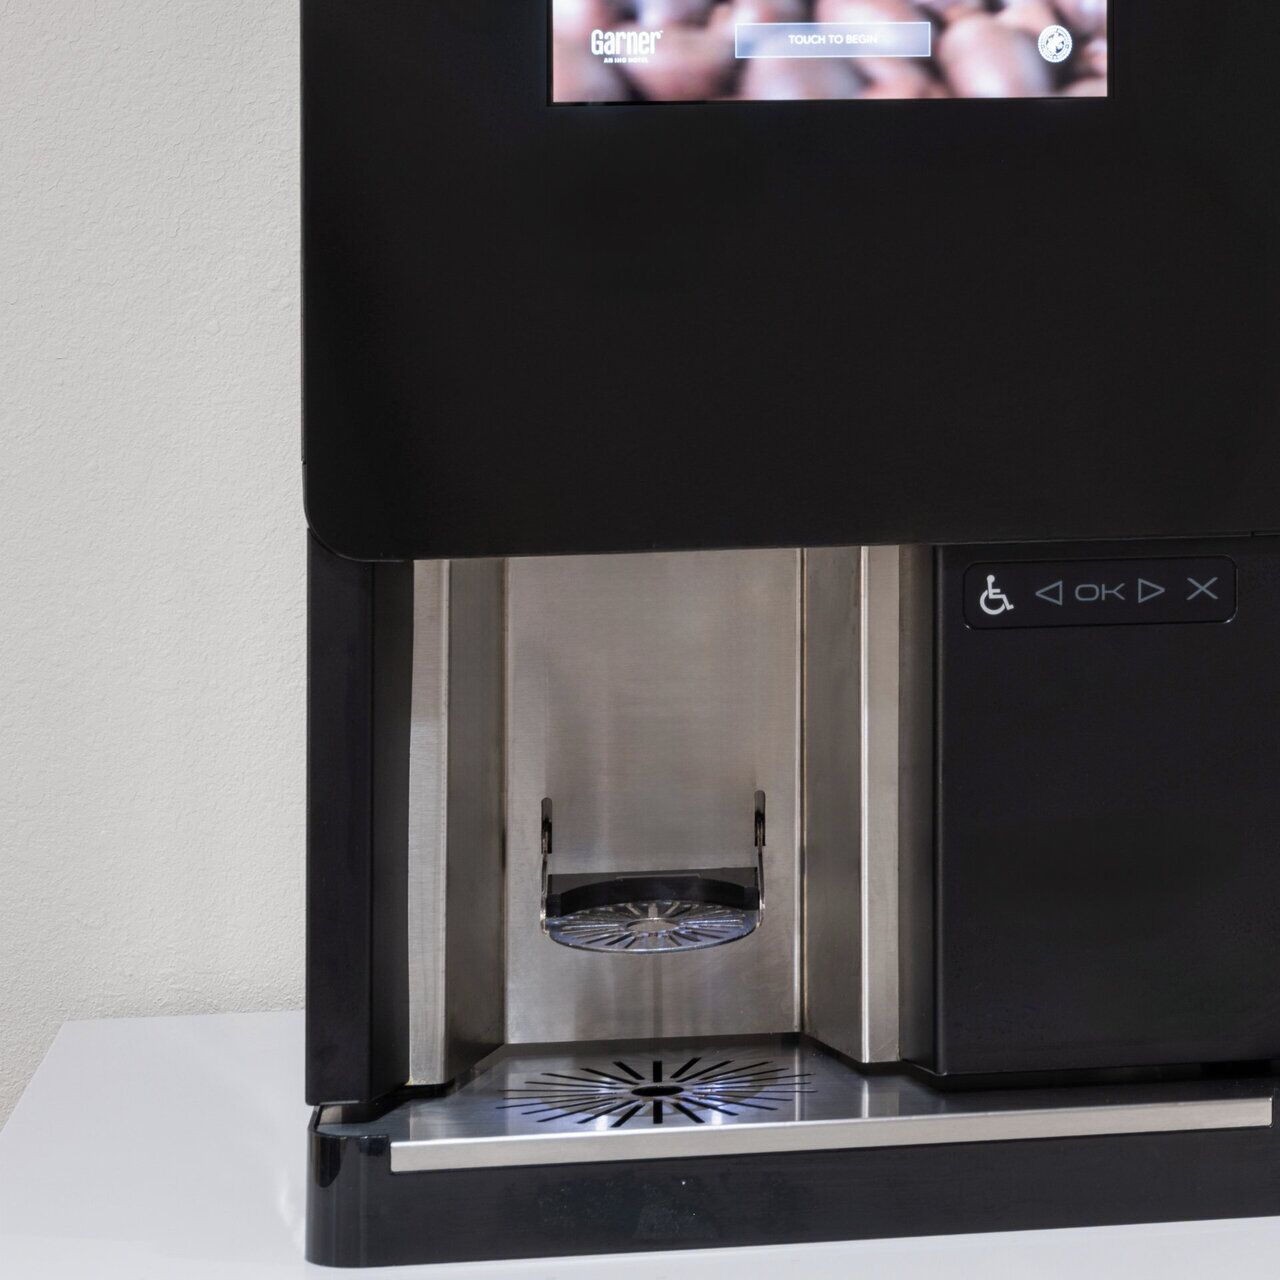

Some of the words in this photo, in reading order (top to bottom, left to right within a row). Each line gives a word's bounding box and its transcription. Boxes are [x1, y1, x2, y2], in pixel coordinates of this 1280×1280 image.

[591, 29, 662, 55] Garner
[788, 34, 826, 45] TOUCH
[828, 34, 844, 45] TO
[846, 33, 877, 44] BEGIN
[1075, 582, 1125, 601] OK
